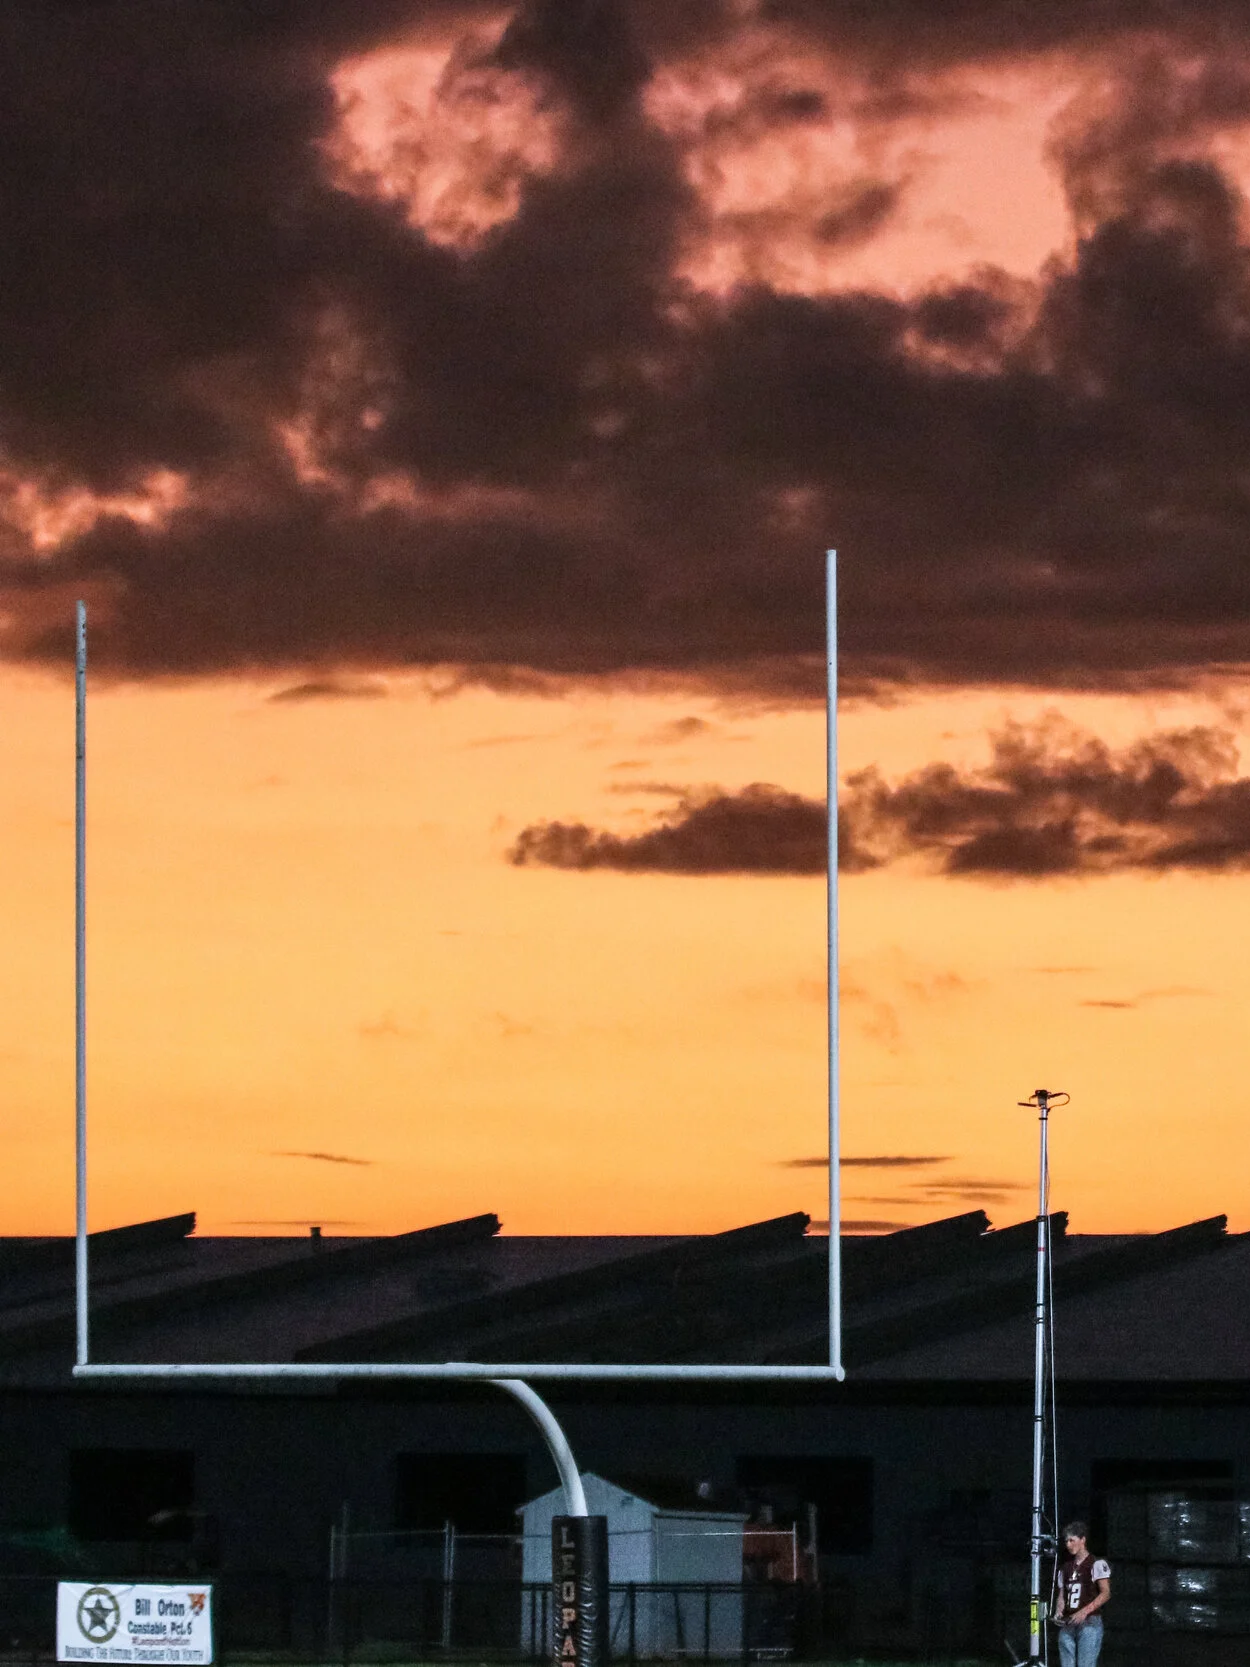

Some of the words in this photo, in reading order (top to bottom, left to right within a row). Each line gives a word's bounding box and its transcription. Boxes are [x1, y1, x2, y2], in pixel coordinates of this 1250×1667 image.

[560, 1526, 577, 1667] LEOPA
[135, 1599, 151, 1616] Bill
[158, 1599, 185, 1616] Orton
[128, 1621, 167, 1635] Constable
